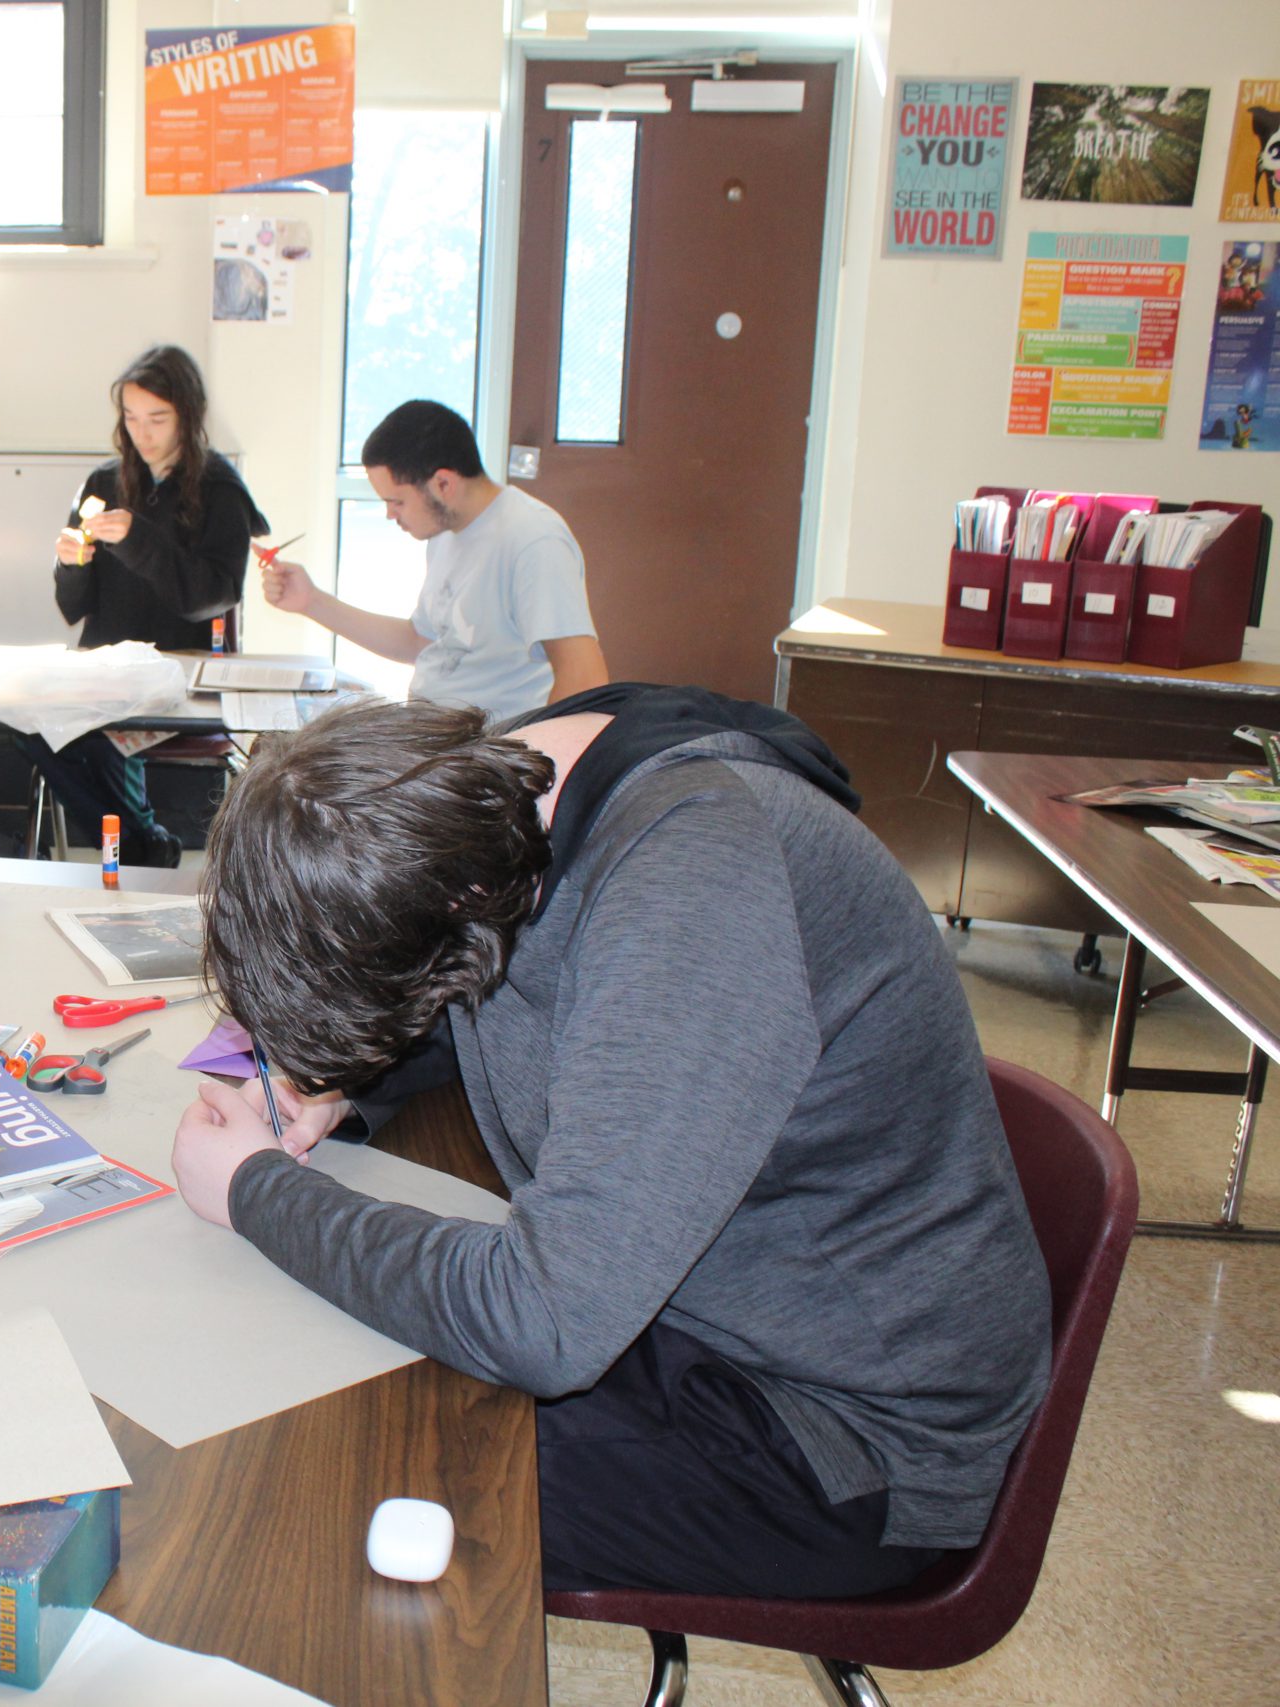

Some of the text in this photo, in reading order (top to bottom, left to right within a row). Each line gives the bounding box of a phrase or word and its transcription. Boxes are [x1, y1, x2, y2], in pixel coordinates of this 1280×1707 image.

[151, 31, 239, 67] STYLES OF
[173, 35, 319, 97] WRITING
[902, 83, 1012, 103] BE THE
[900, 103, 1007, 138] CHANGE
[538, 138, 552, 163] 7
[916, 139, 985, 167] YOU
[1074, 127, 1159, 161] BREATHE
[897, 167, 961, 190] WANT
[895, 190, 998, 209] SEE IN THE
[894, 209, 996, 246] WORLD
[1056, 236, 1160, 260] PUNCTUATION
[1069, 264, 1166, 277] QUESTION MARK
[1142, 301, 1179, 310] COMMA
[1220, 316, 1265, 325] PERSUASIVE
[1027, 333, 1107, 344] PARENTHESES
[1014, 370, 1047, 380] COLON
[1061, 372, 1122, 384] QUOTATION
[1052, 406, 1164, 418] EXCLAMATION POINT
[27, 1102, 71, 1138] MARTHA STEWART
[0, 1585, 16, 1673] AMERICAN
